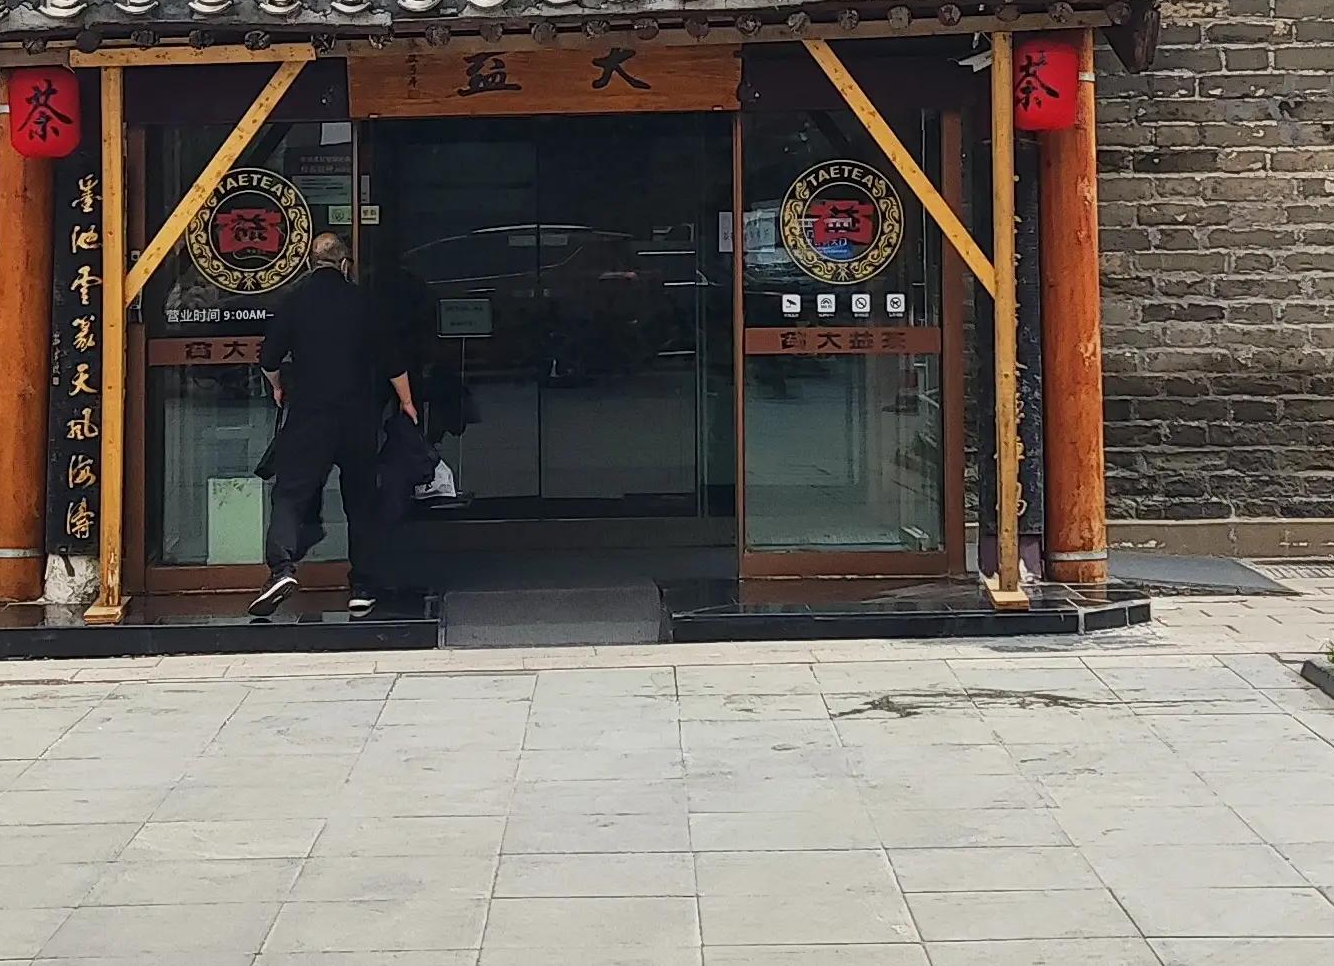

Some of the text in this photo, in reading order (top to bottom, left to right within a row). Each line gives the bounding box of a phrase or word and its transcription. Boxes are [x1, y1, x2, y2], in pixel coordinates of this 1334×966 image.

[17, 79, 73, 143] 茶
[217, 173, 283, 197] TAETEA
[806, 165, 874, 188] TAETEA
[167, 308, 221, 323] 营业时间
